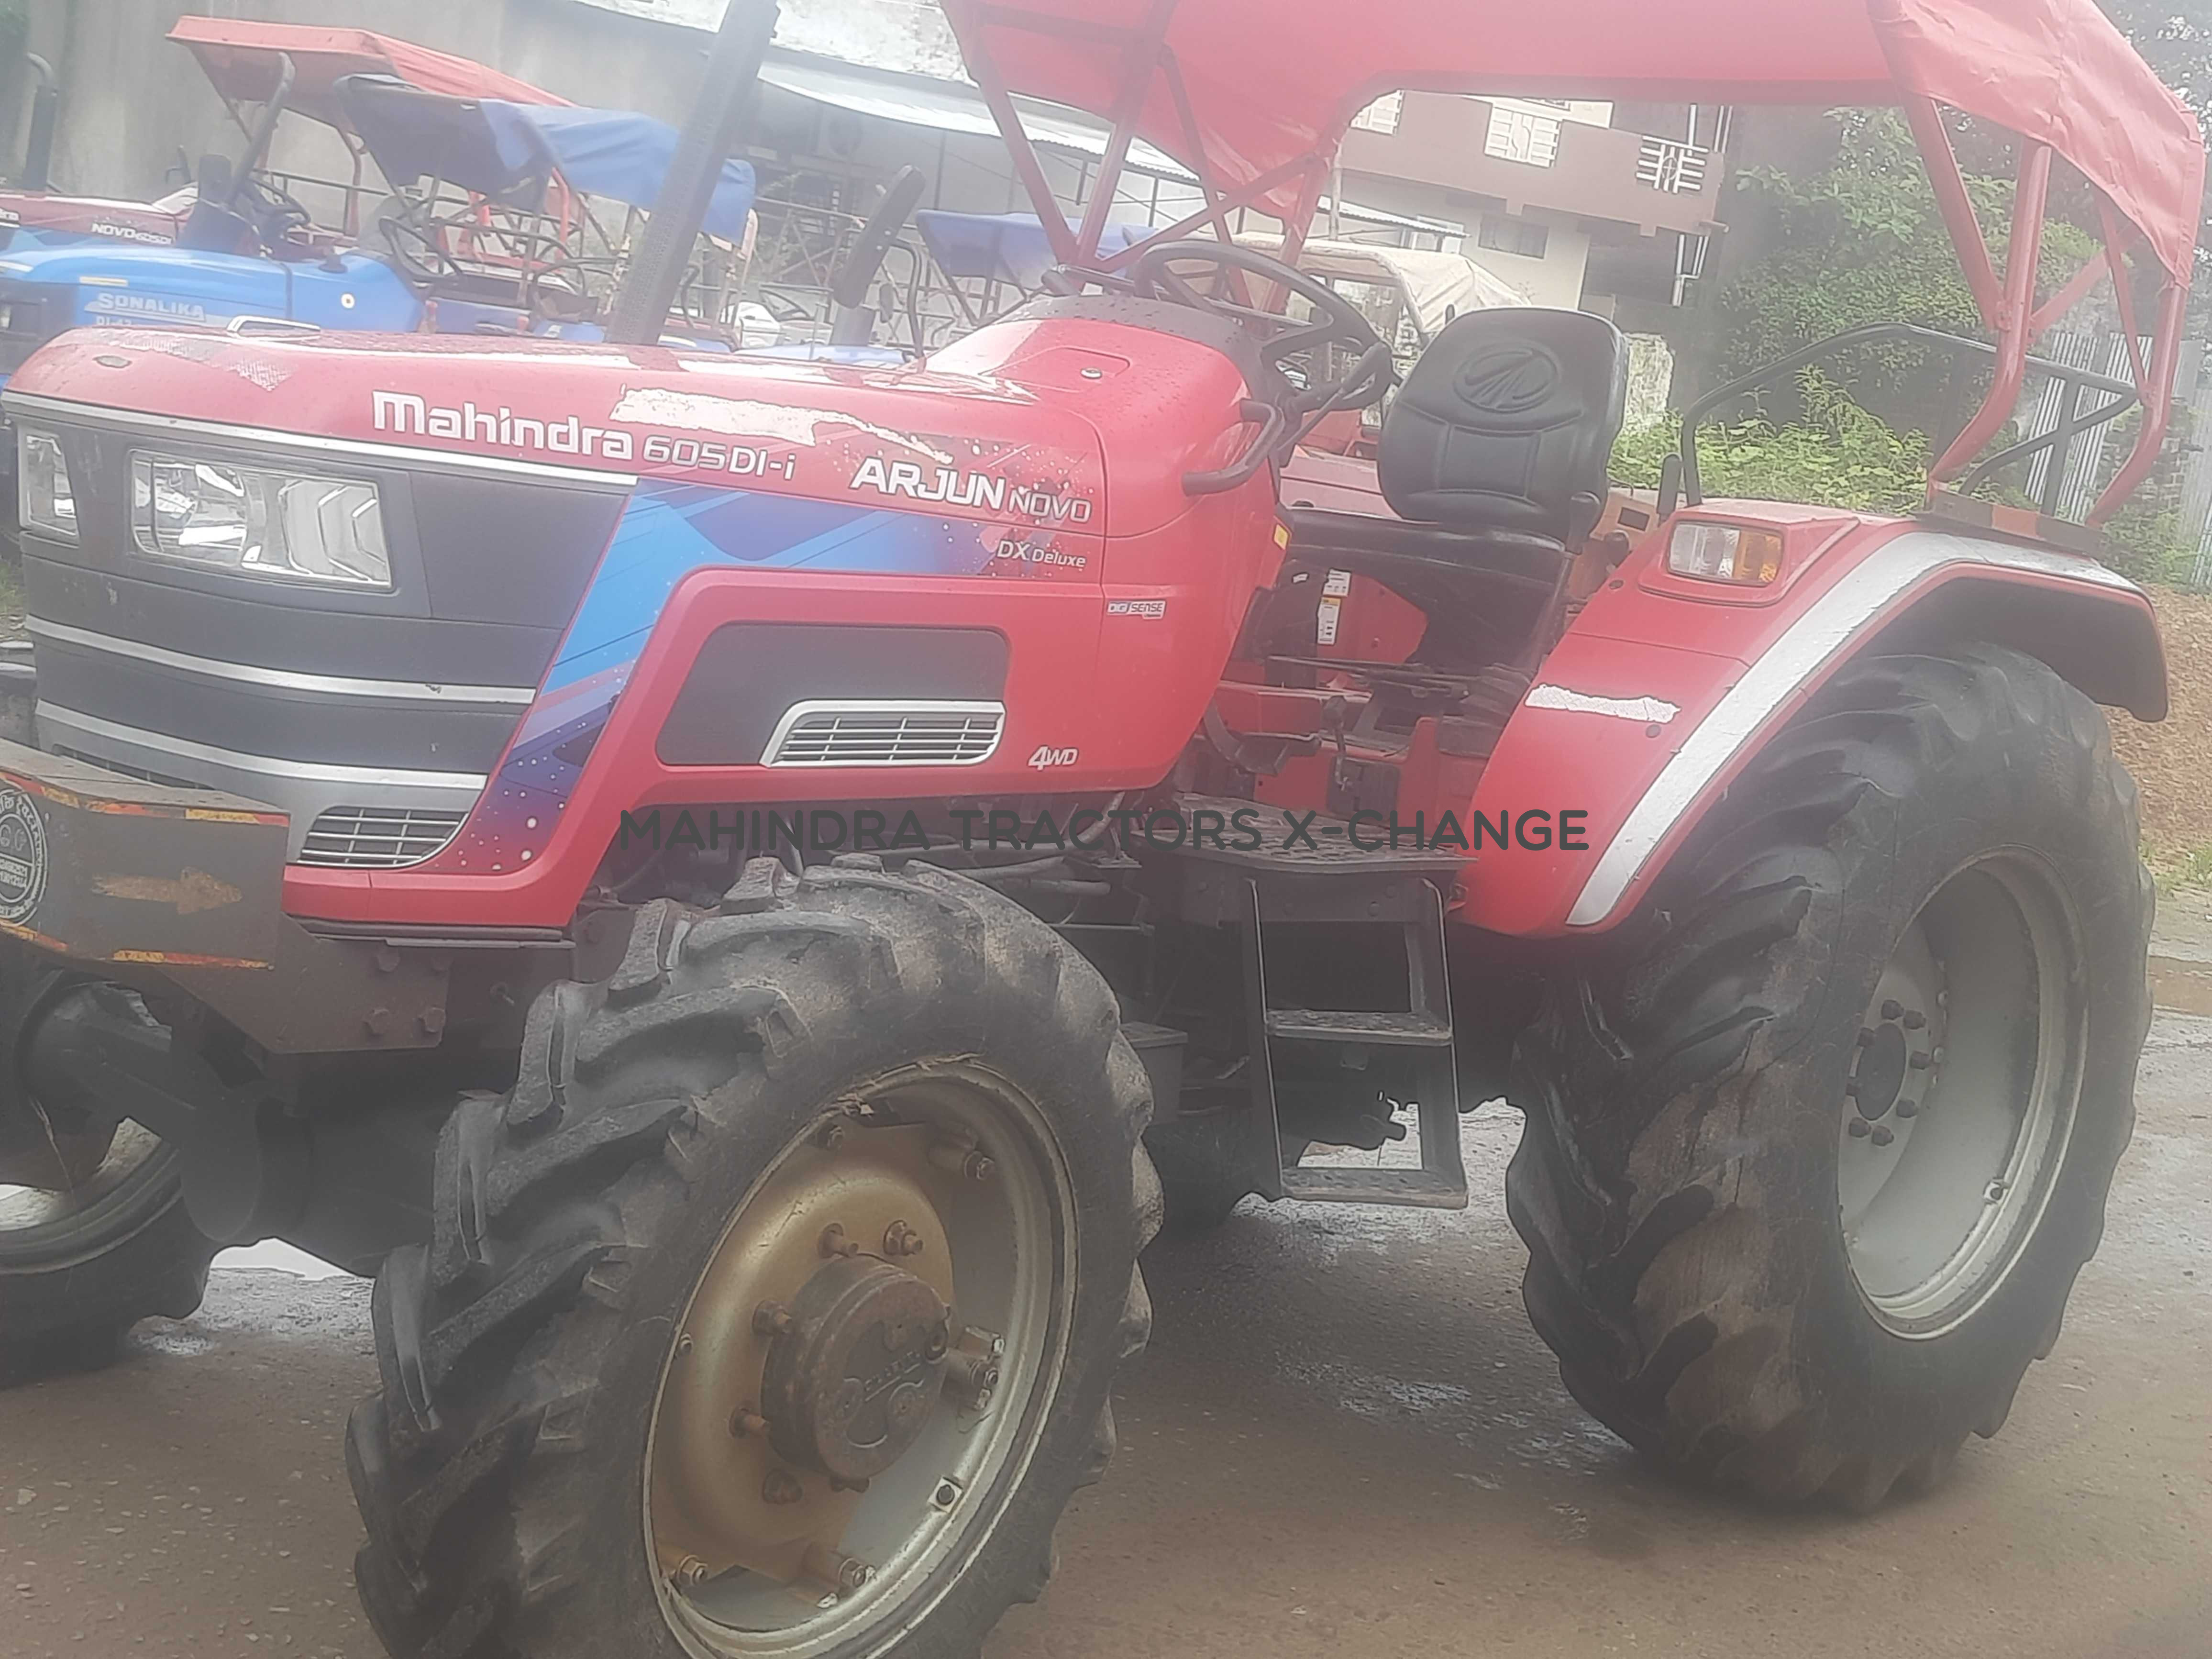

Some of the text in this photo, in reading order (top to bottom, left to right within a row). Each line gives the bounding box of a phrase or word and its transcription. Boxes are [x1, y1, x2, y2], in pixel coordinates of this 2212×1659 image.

[91, 223, 136, 238] NOVO
[99, 293, 204, 320] SONALIKA
[372, 390, 796, 480] Mahindra 605DI-i
[849, 457, 1091, 523] ARJUN NOVO
[997, 541, 1086, 568] DX Deluxe
[1028, 746, 1078, 771] 4WD
